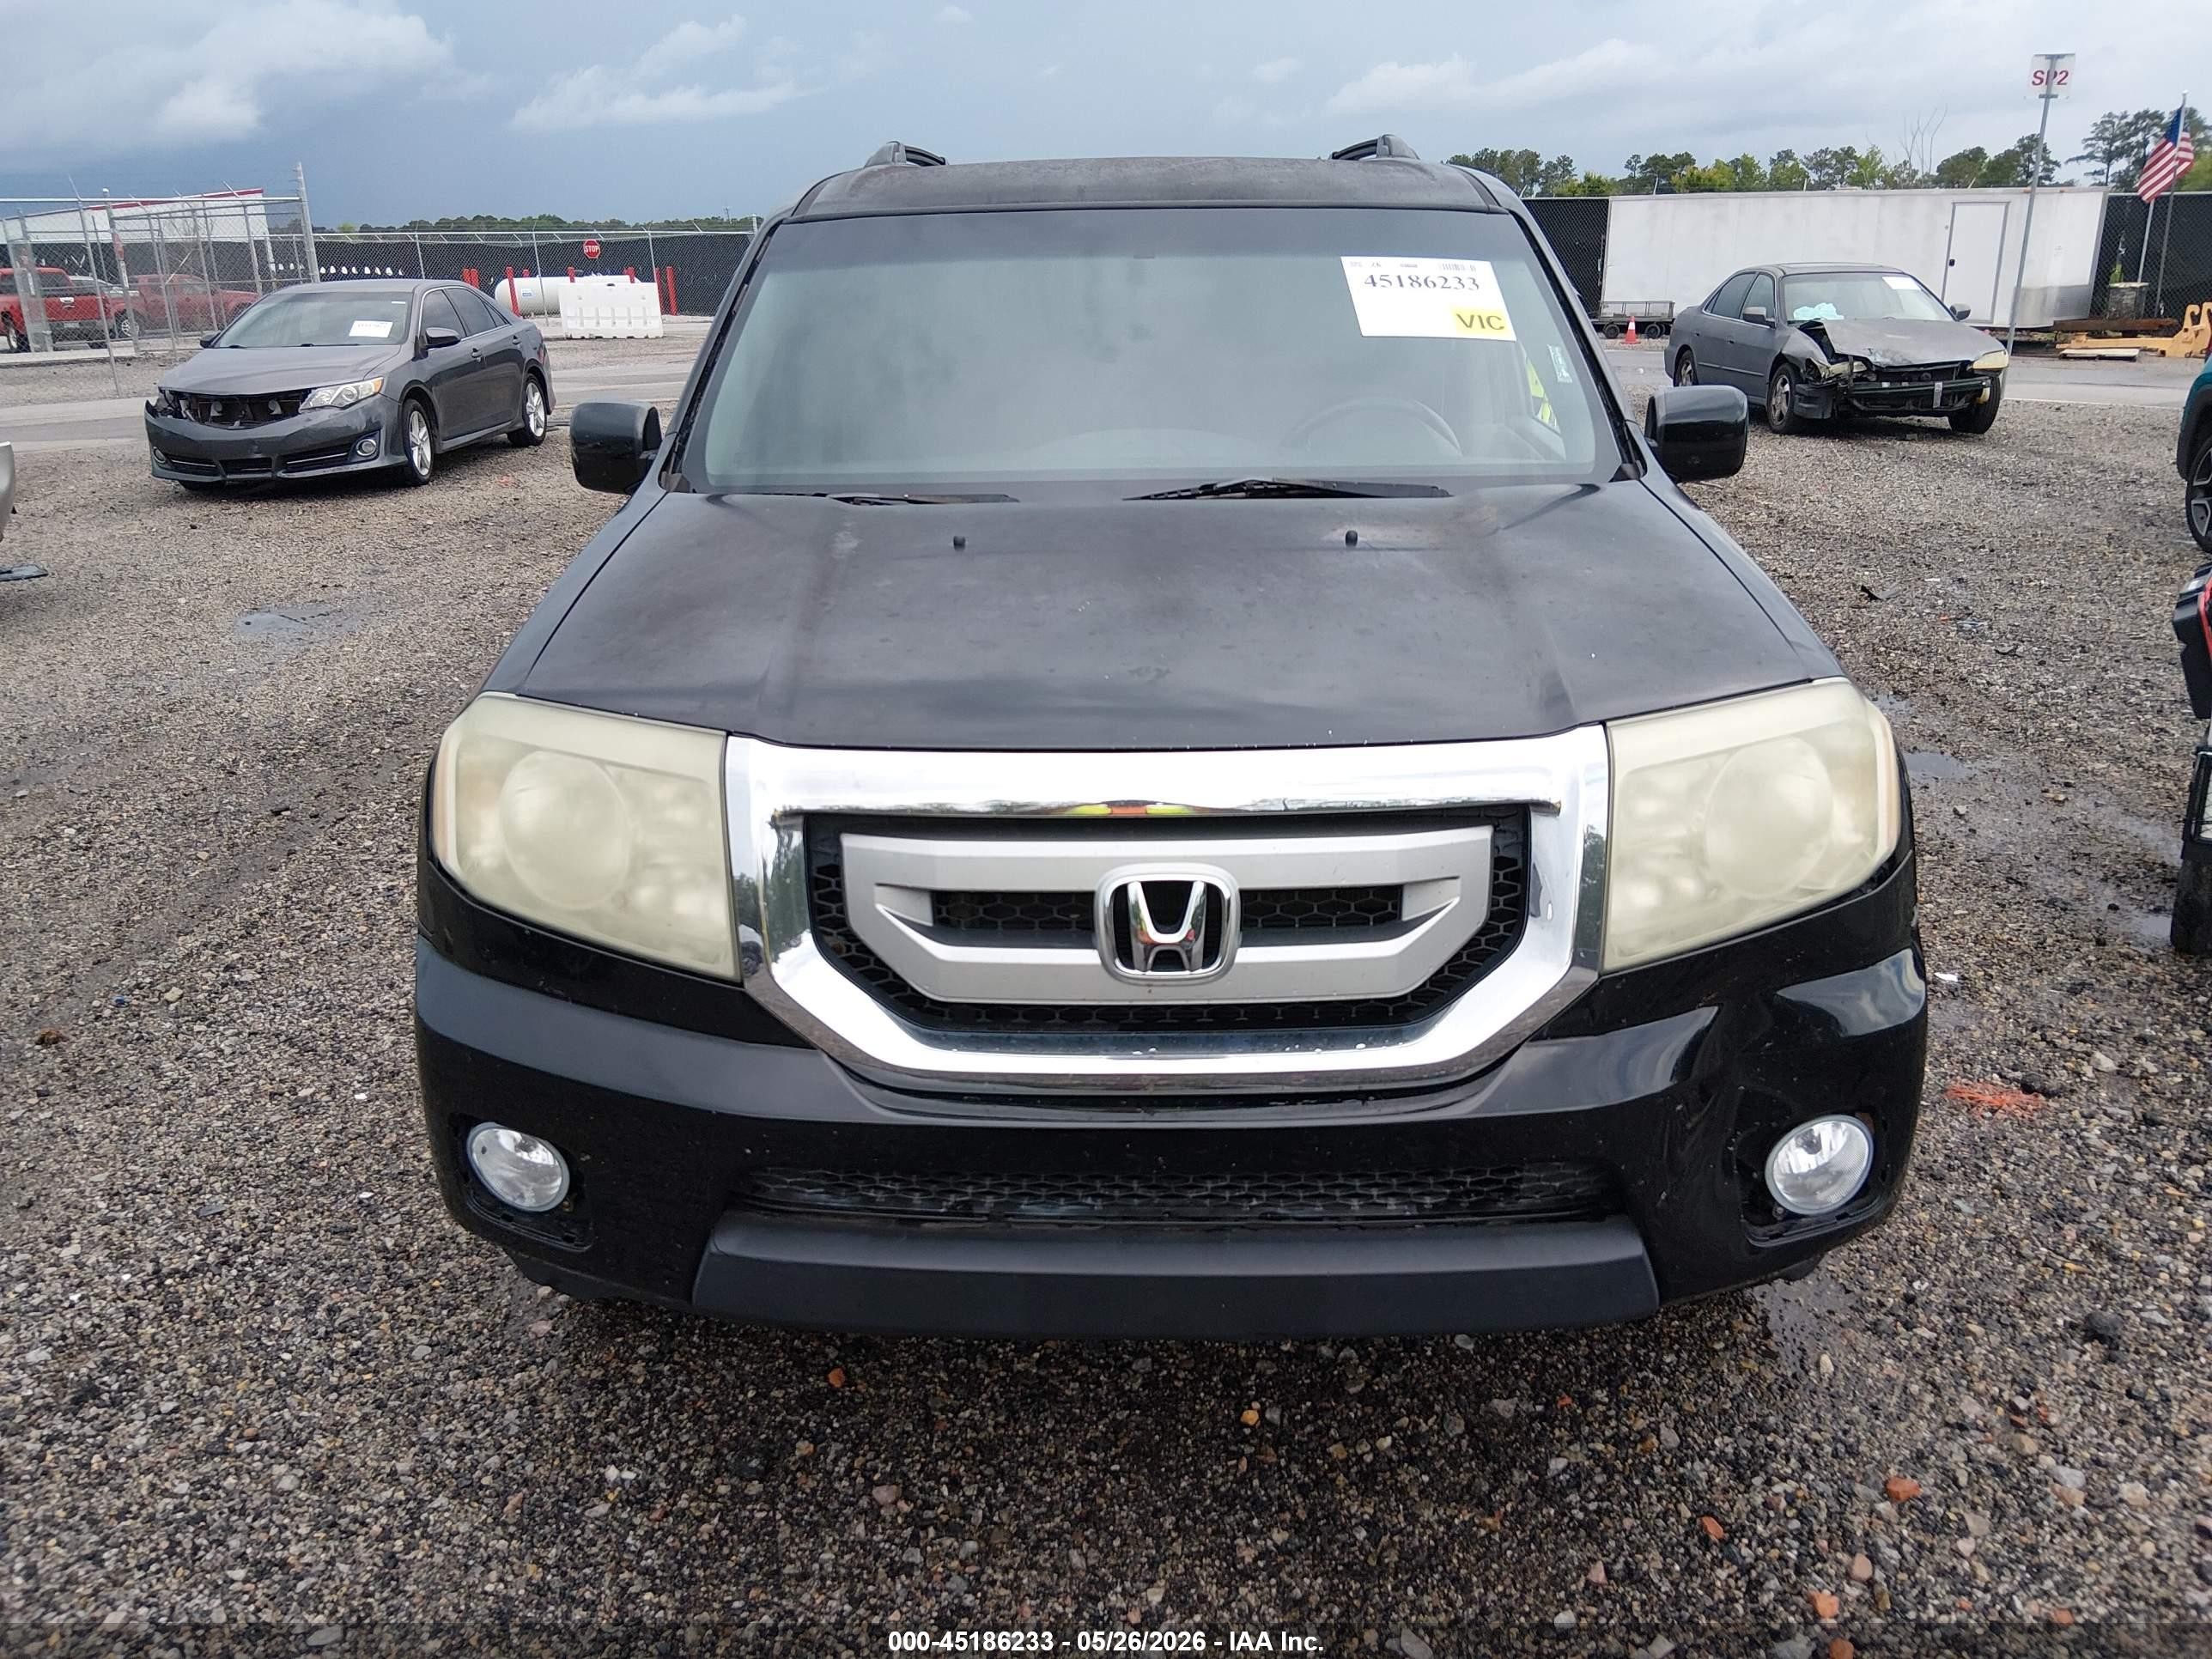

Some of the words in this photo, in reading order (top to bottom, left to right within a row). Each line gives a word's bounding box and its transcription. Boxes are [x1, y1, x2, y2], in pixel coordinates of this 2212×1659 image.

[584, 245, 600, 253] STOP
[1364, 274, 1480, 291] 45186233
[1456, 313, 1505, 331] VIC
